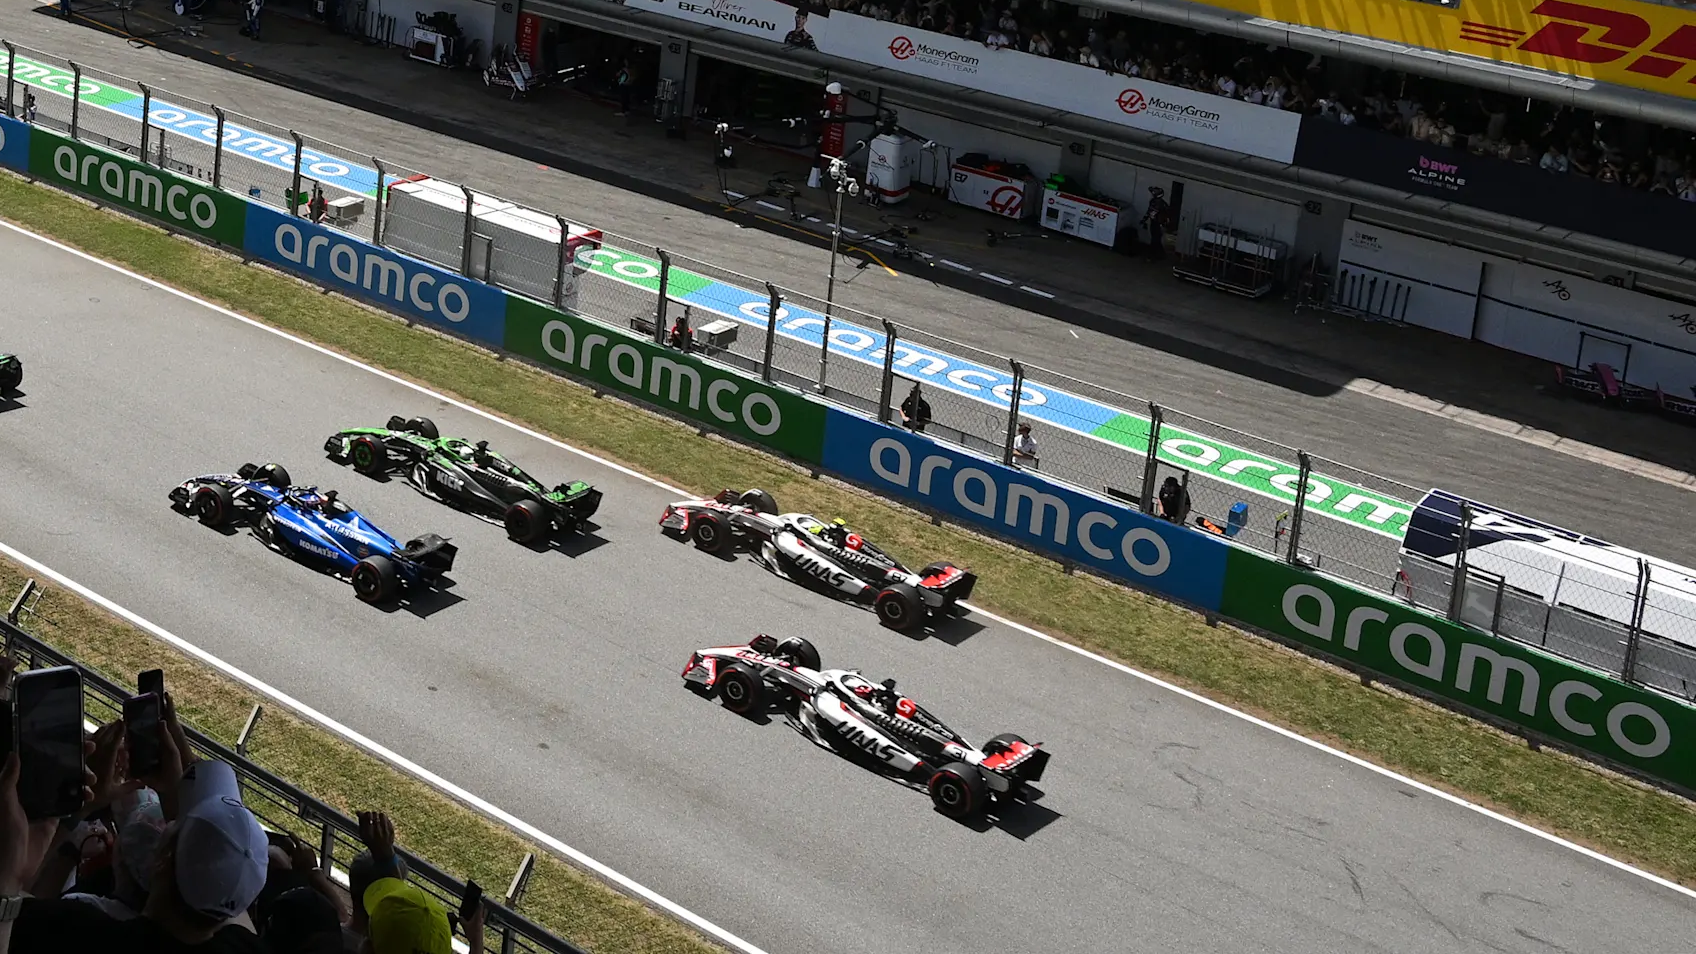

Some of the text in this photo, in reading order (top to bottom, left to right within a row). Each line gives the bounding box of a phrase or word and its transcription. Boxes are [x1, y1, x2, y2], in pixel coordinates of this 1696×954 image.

[678, 1, 776, 32] BEARMAN
[914, 54, 978, 74] HAAS F1 TEAM
[916, 43, 980, 66] MoneyGram
[1146, 109, 1218, 132] HAAS F1 TEAM
[1148, 96, 1220, 121] MoneyGram
[148, 108, 350, 177] aramco
[1408, 168, 1468, 186] ALPINE
[1430, 160, 1459, 174] BWT
[54, 146, 217, 229] aramco
[274, 223, 470, 323] aramco
[739, 301, 1048, 406] aramco
[540, 319, 782, 436] aramco
[436, 470, 464, 492] KICK
[1161, 438, 1412, 532] aram
[870, 437, 1171, 577] aramco
[300, 540, 339, 560] KOMATSU
[1282, 583, 1672, 758] aramco
[953, 749, 968, 762] 31
